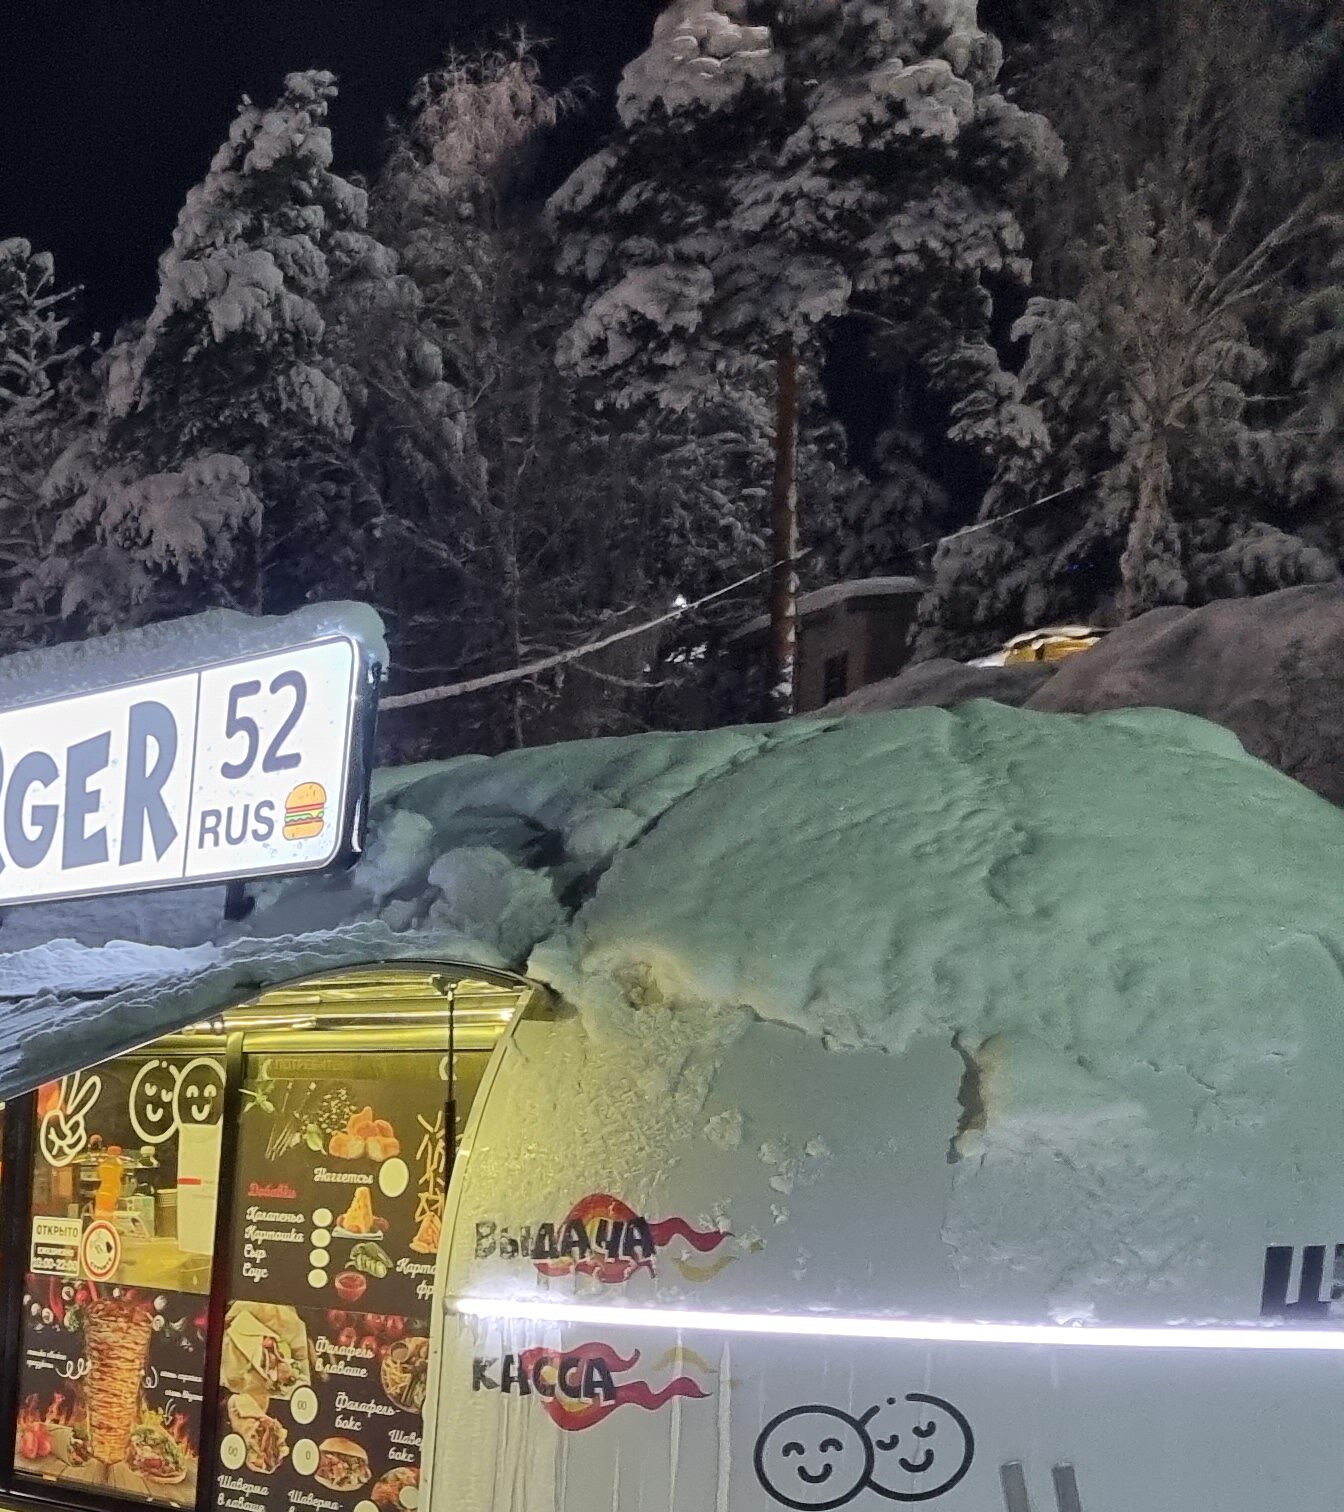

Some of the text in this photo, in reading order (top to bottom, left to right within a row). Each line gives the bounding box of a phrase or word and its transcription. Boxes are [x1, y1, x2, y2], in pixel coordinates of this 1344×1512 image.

[221, 671, 307, 779] 52
[197, 801, 275, 849] RUS
[36, 1224, 79, 1238] ОТКРЫТО
[244, 1225, 305, 1244] Картошка
[244, 1244, 267, 1263] Сыр
[242, 1262, 269, 1282] Соус
[315, 1336, 375, 1361] Фалафель
[473, 1355, 616, 1403] КАССА
[335, 1414, 363, 1432] бокс
[388, 1446, 416, 1463] бокс
[217, 1474, 270, 1497] Шаверма
